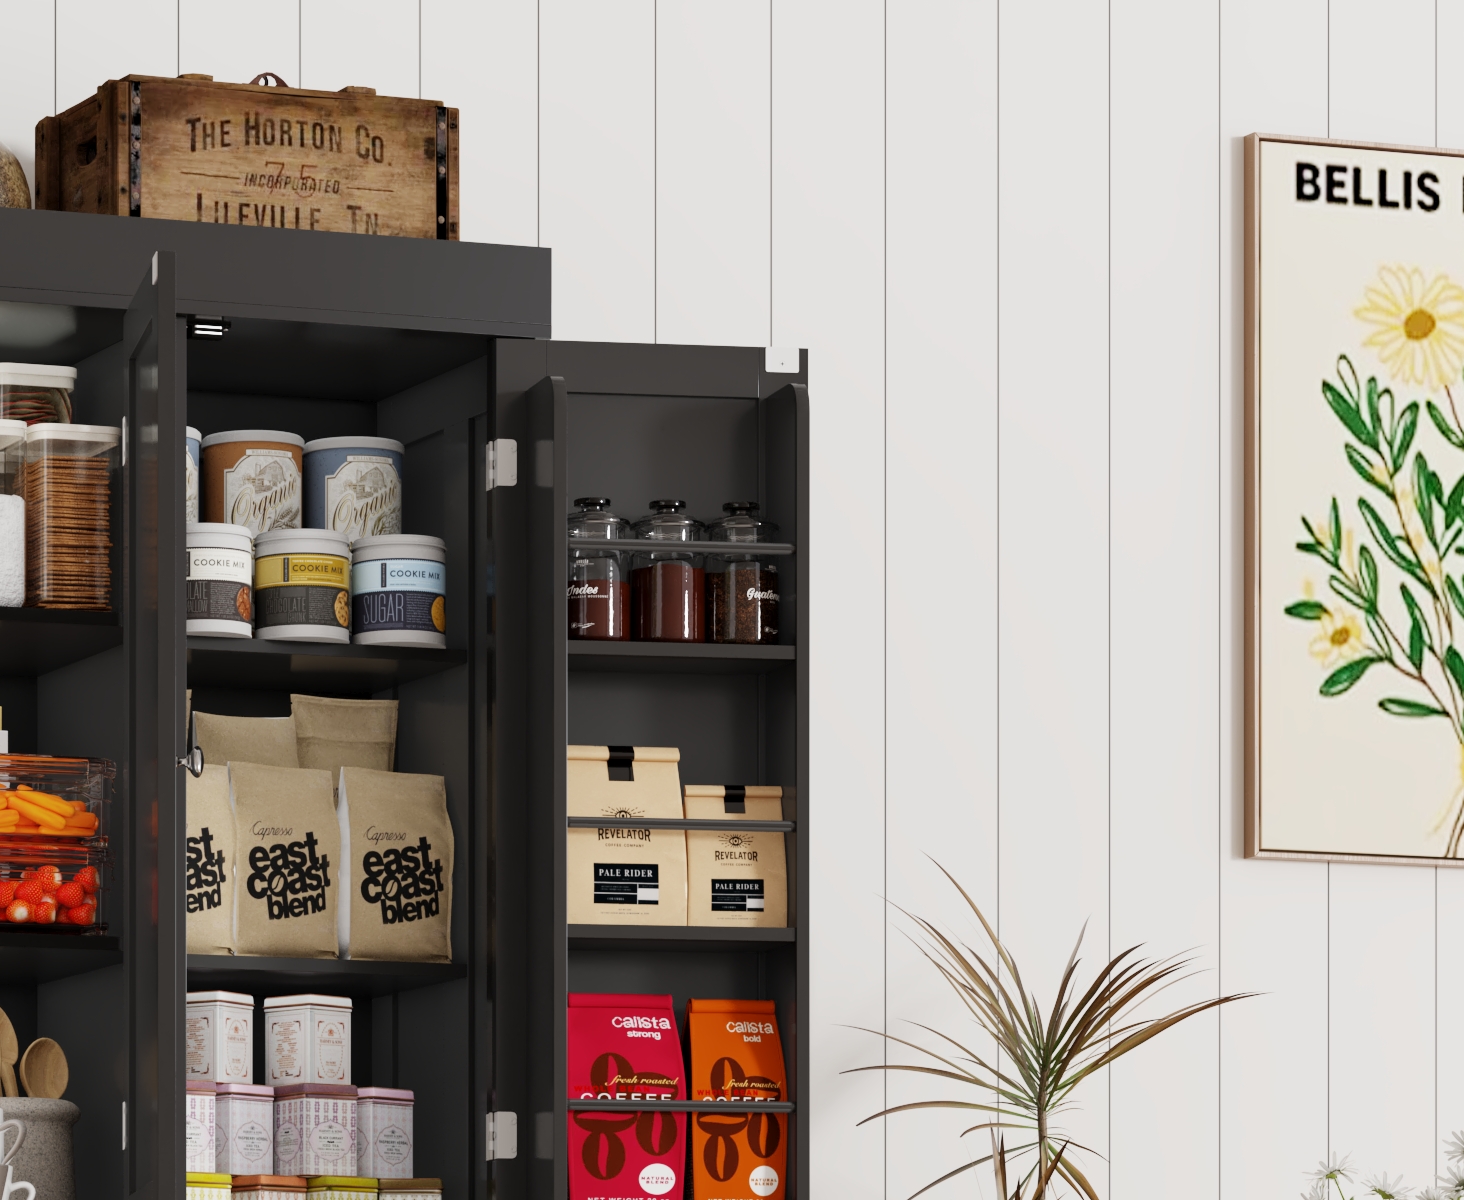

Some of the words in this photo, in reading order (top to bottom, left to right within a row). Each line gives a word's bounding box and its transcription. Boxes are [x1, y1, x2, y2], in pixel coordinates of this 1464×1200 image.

[1295, 162, 1440, 212] BELLIS
[231, 473, 297, 532] Organic
[332, 479, 398, 537] Organic
[193, 559, 230, 567] COOKIE
[232, 559, 245, 569] MIX
[292, 564, 329, 573] COOKIE
[331, 566, 344, 575] MIX
[390, 570, 426, 578] COOKIE
[428, 573, 441, 581] MIX
[363, 593, 404, 624] SUGAR
[249, 820, 293, 842] Capresso
[363, 825, 407, 845] Capresso
[598, 828, 651, 842] REVELATOR
[248, 832, 320, 873] east
[362, 837, 433, 878] east
[715, 850, 758, 862] REVELATOR
[247, 854, 330, 899] coast
[360, 859, 444, 904] coast
[599, 868, 622, 877] PALE
[624, 869, 653, 878] RIDER
[267, 886, 326, 920] blend
[381, 891, 440, 925] blend
[626, 1030, 661, 1040] strong
[743, 1035, 761, 1043] bold
[574, 1085, 613, 1093] WHOLE
[619, 1085, 650, 1093] BEAN
[604, 1074, 638, 1086] fresh
[640, 1076, 679, 1086] roasted
[721, 1078, 749, 1090] fresh
[750, 1081, 782, 1089] roasted
